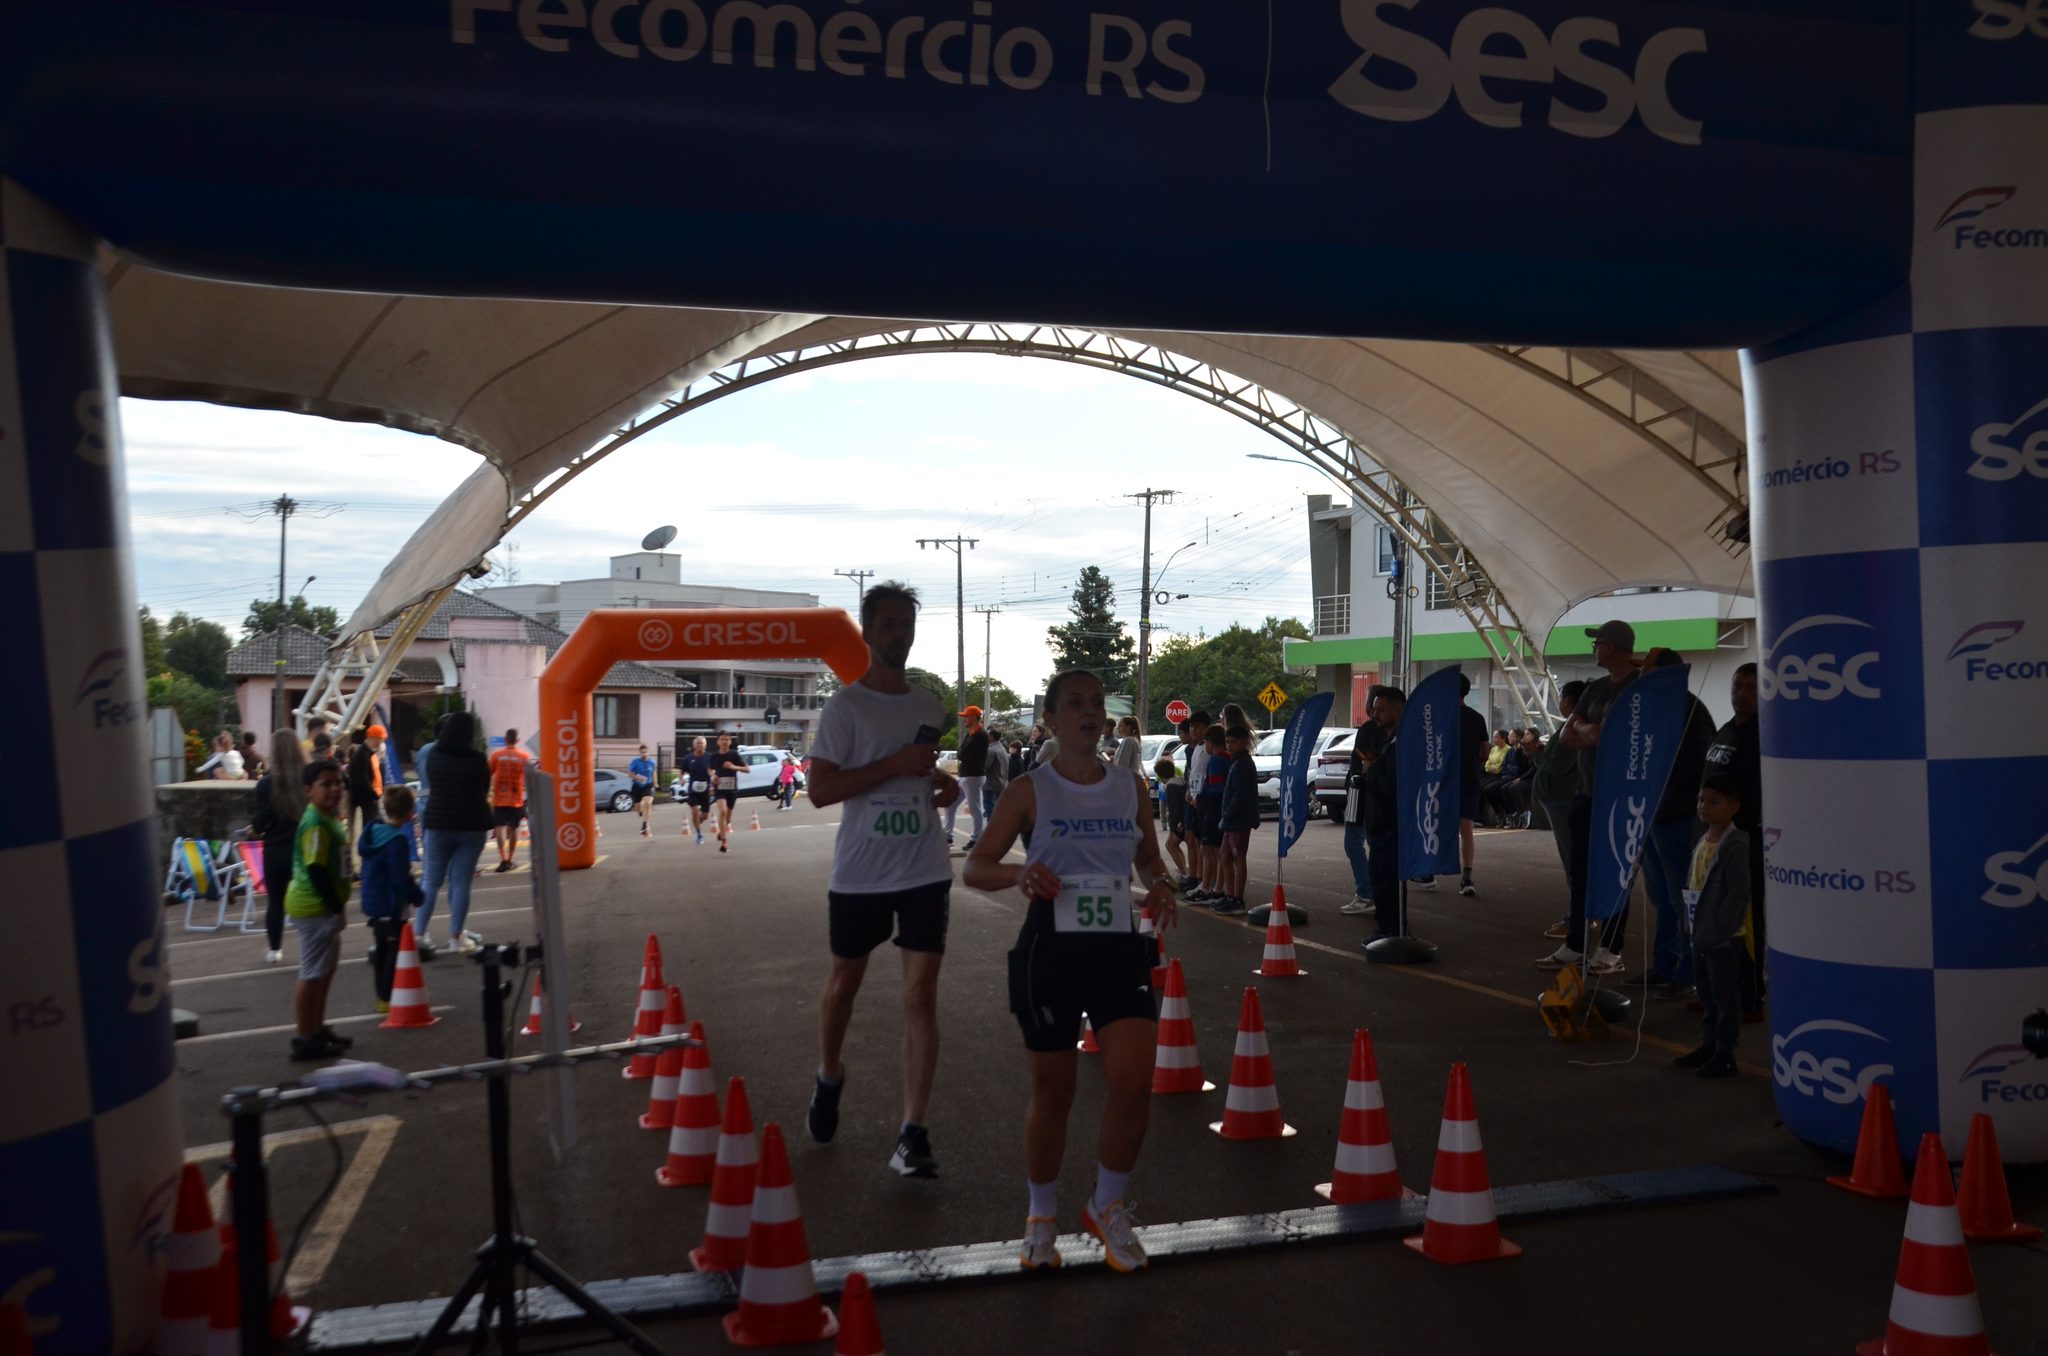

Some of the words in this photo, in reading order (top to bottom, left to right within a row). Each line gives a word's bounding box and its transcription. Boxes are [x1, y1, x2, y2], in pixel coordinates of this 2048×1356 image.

[1084, 12, 1206, 104] RS
[1858, 450, 1901, 475] RS
[683, 621, 807, 646] CRESOL
[1167, 708, 1188, 717] PARE
[1422, 703, 1434, 772] Fecomércio
[1626, 692, 1642, 780] Fecomércio
[557, 709, 581, 815] CRESOL
[874, 809, 921, 836] 400
[1068, 818, 1135, 833] VETRIA
[1873, 870, 1917, 894] RS
[1077, 895, 1113, 927] 55
[9, 995, 66, 1036] RS
